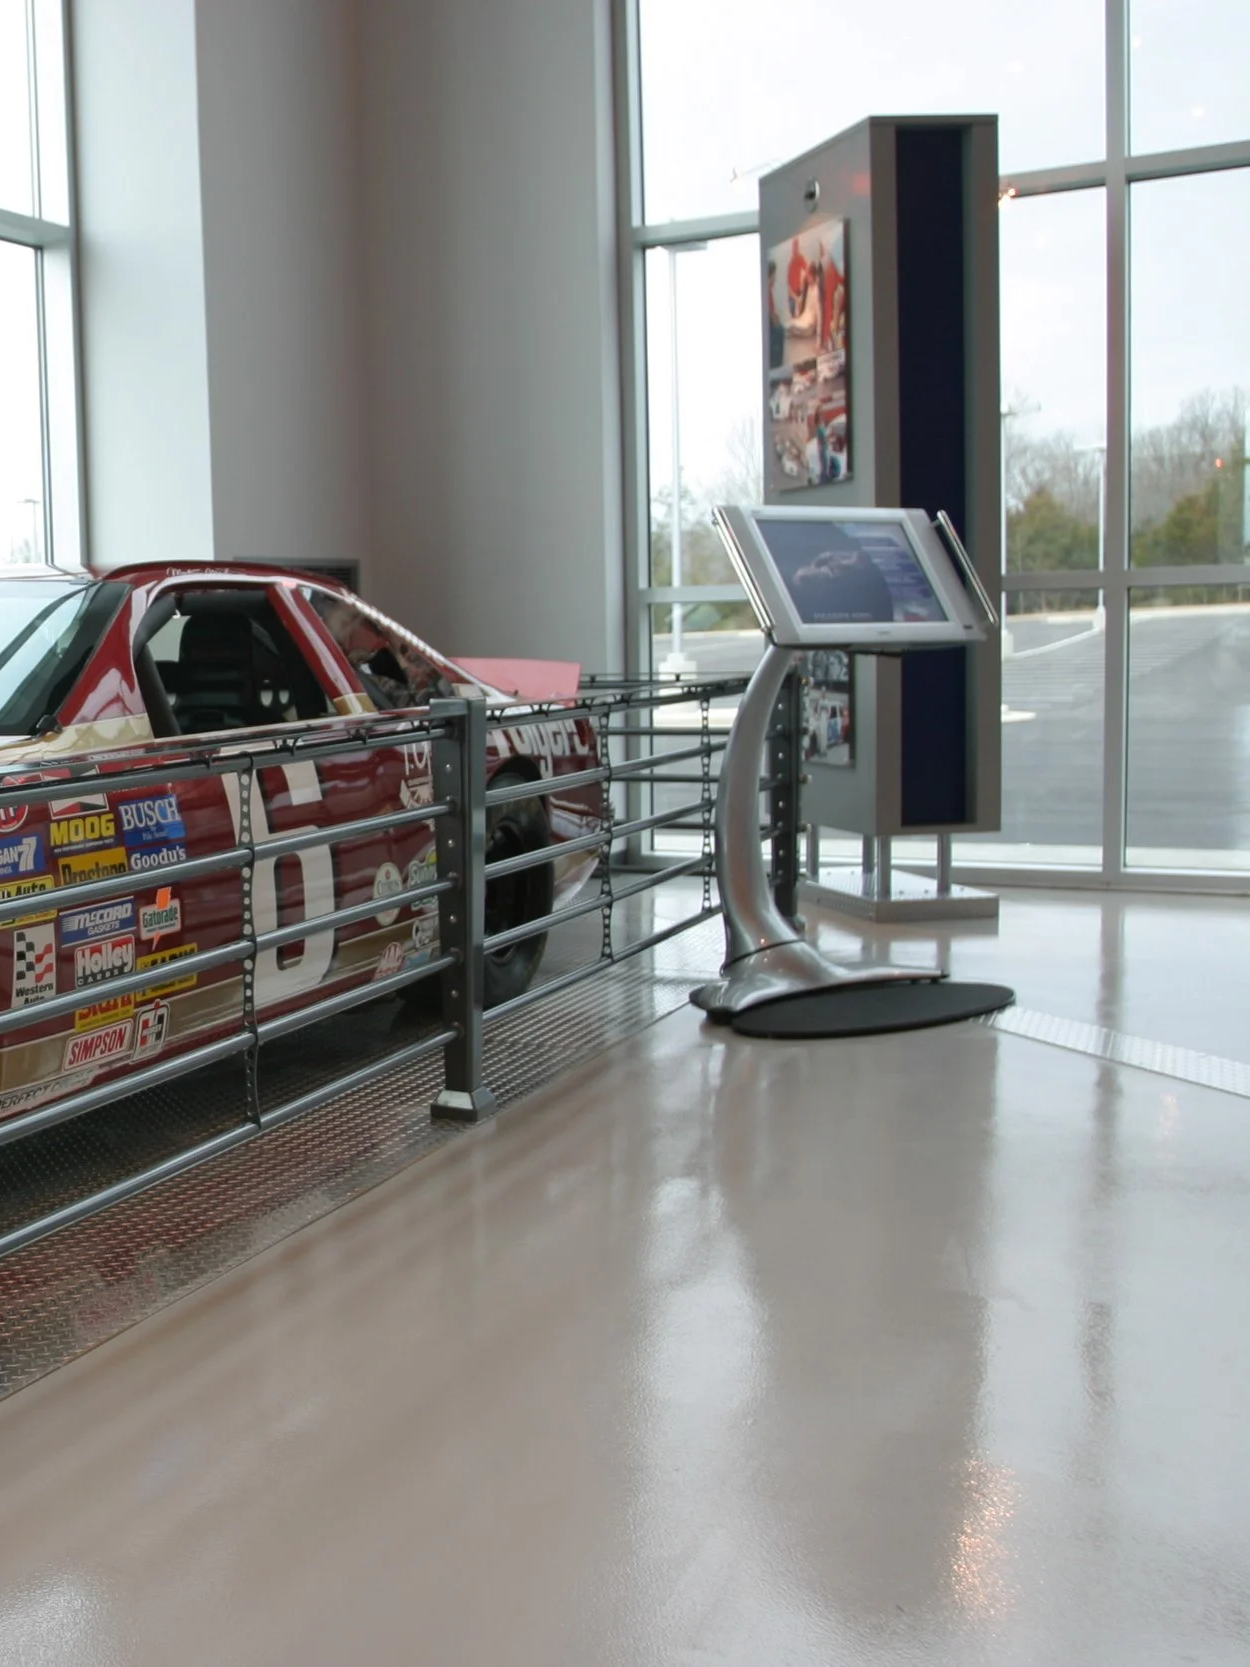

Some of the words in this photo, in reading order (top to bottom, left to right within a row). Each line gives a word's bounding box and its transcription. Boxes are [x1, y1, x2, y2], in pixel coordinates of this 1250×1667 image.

[50, 813, 116, 846] MOOG
[118, 794, 181, 831] BUSCH
[18, 836, 38, 872] 77
[87, 920, 120, 936] GASKETS
[142, 905, 179, 928] Gatorade
[76, 941, 133, 977] Holley
[15, 982, 54, 998] Western
[68, 1025, 128, 1066] SIMPSON
